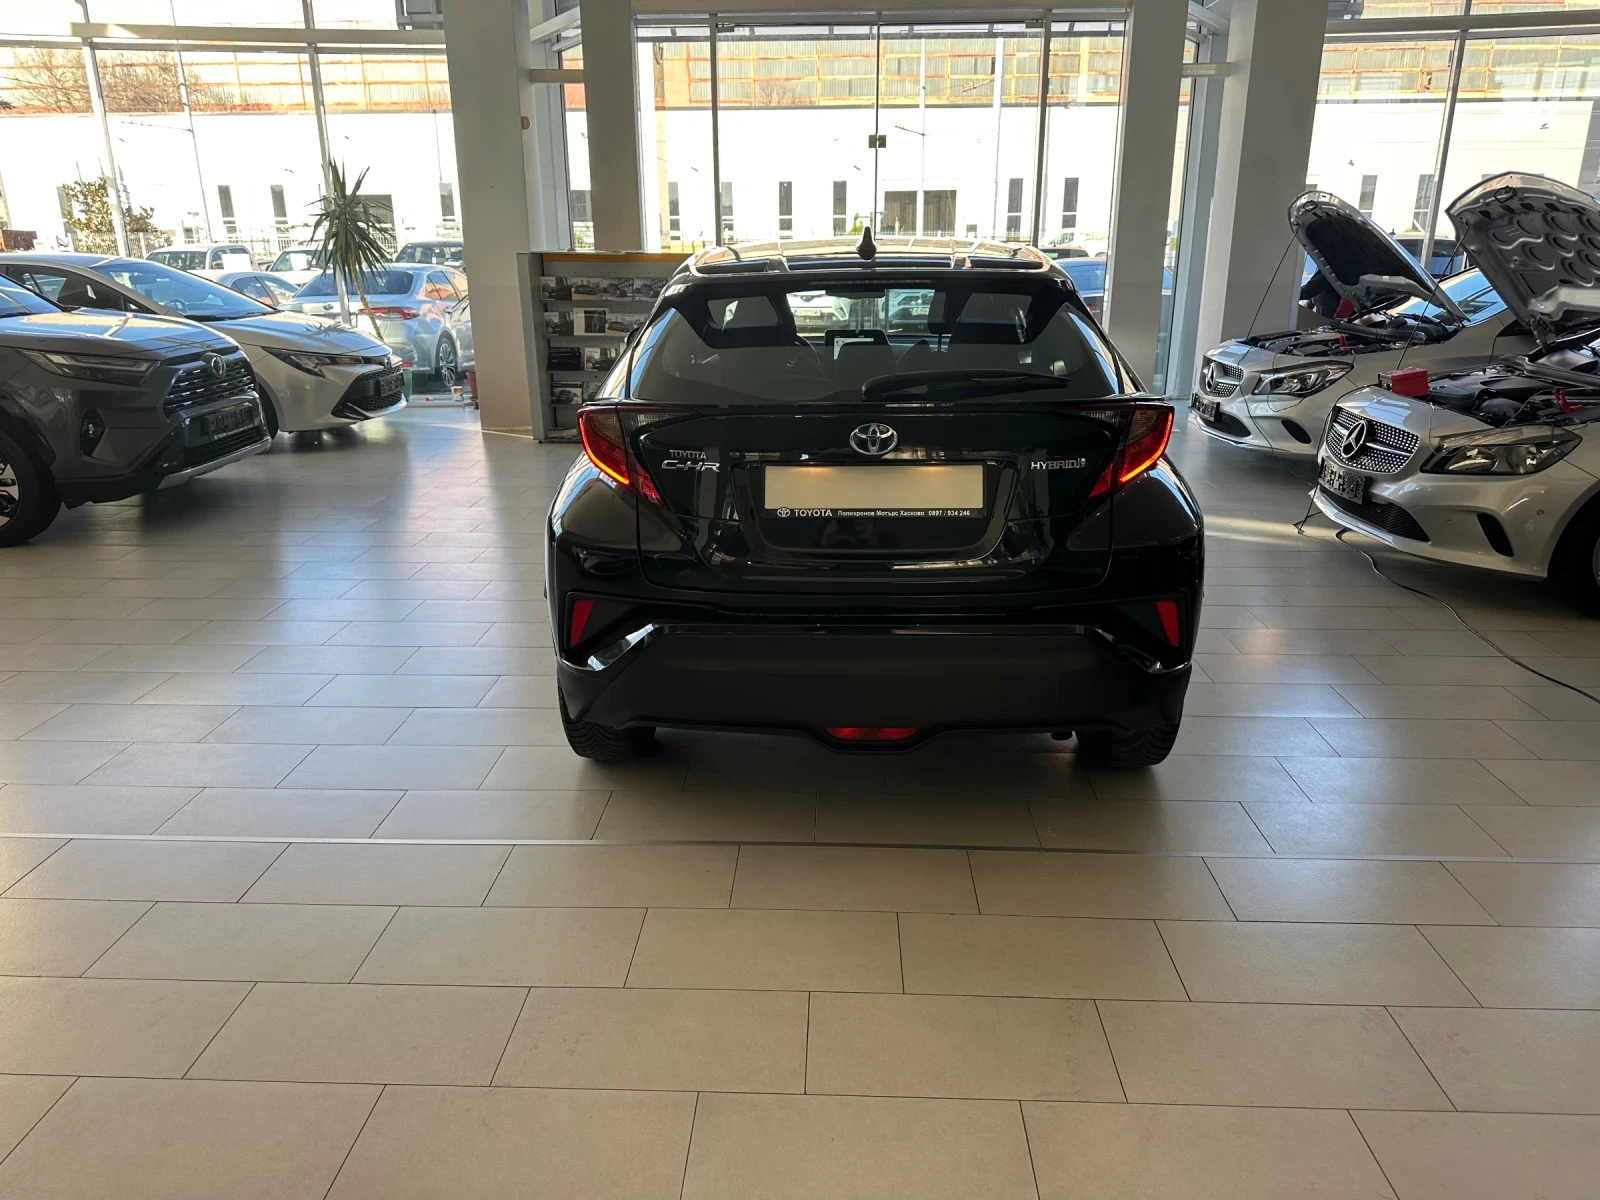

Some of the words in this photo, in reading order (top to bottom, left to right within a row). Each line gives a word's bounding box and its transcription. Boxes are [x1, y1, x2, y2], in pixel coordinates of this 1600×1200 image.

[669, 449, 708, 460] TOYOTA
[661, 459, 721, 472] C-HR
[1030, 459, 1078, 470] HYBRID
[793, 509, 833, 517] TOYOTA
